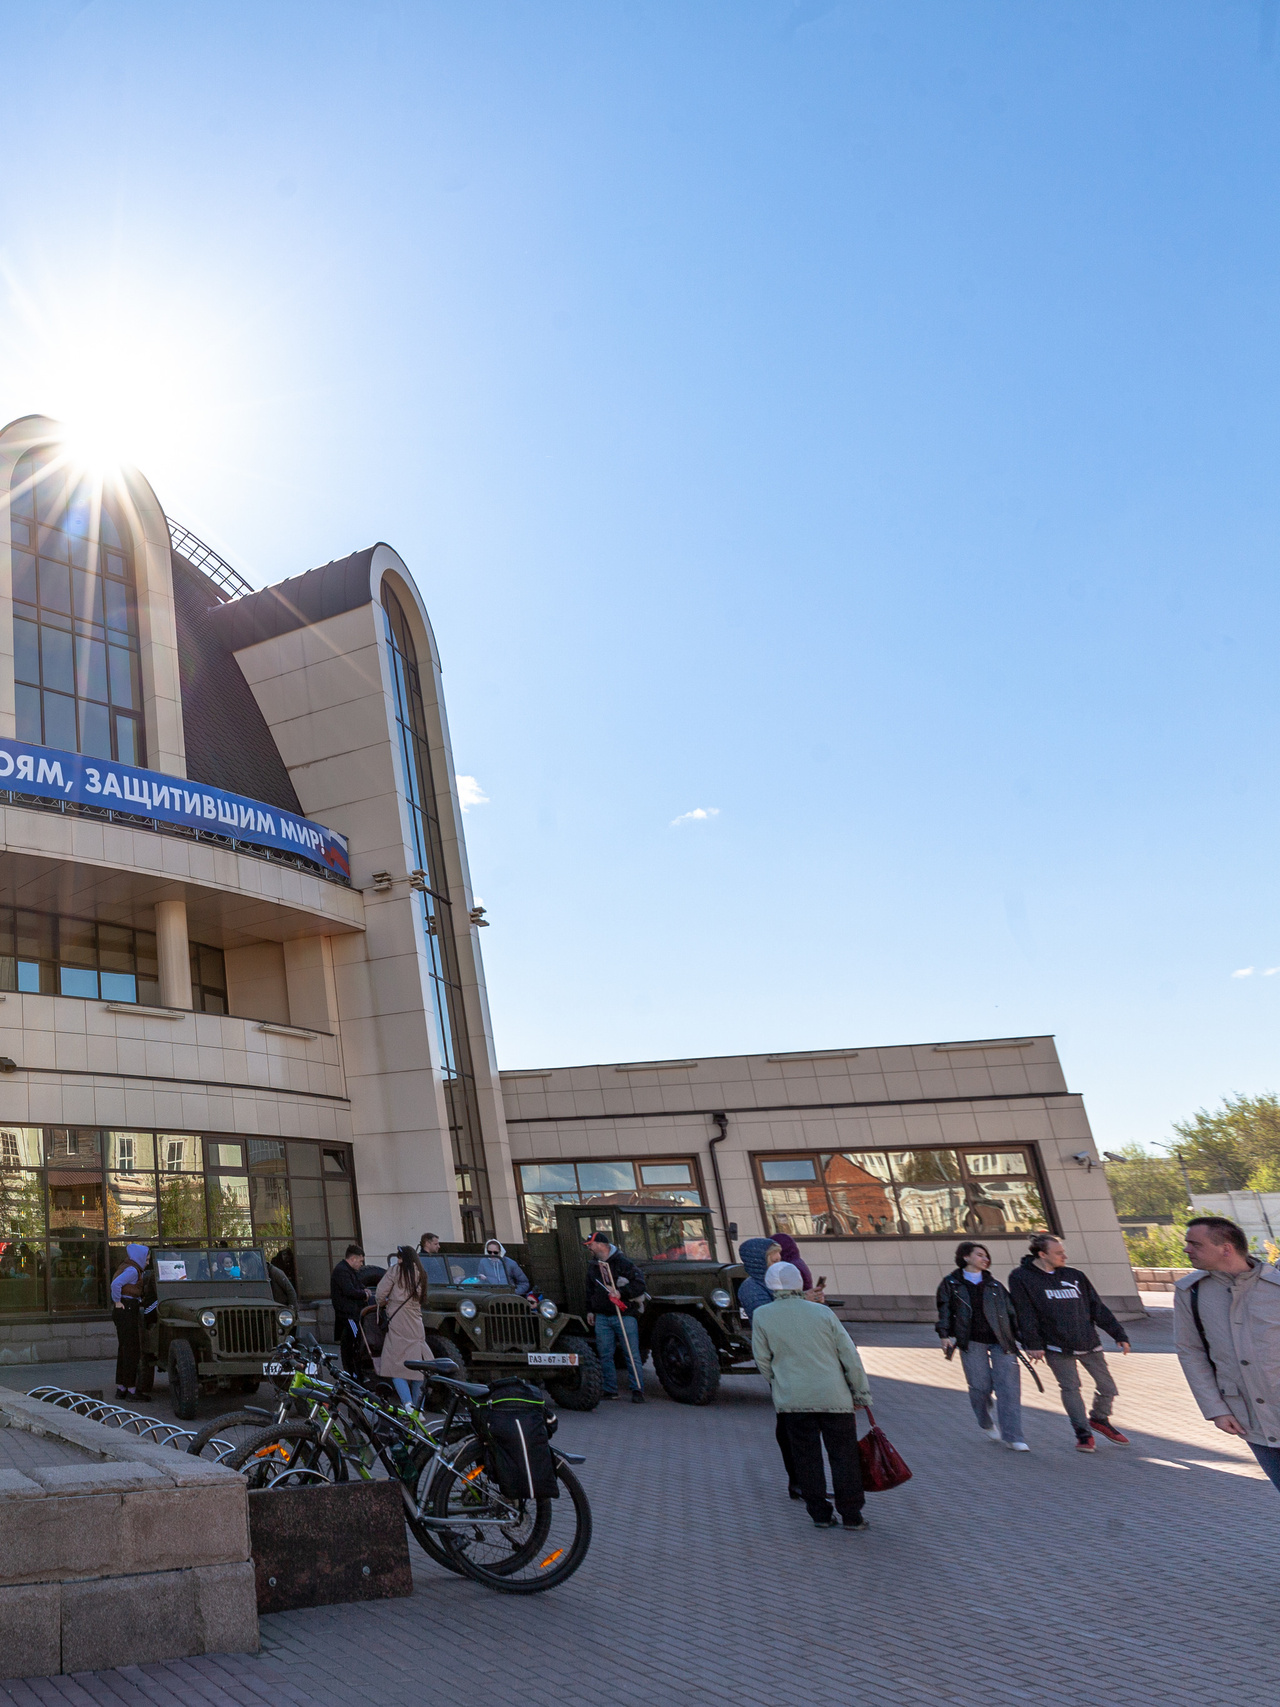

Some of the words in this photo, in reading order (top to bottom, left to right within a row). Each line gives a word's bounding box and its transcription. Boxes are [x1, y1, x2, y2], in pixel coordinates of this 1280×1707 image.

[85, 767, 276, 836] ЗАЩИТИВШИМ
[281, 816, 326, 855] МИР!
[1045, 1289, 1080, 1299] PUMA
